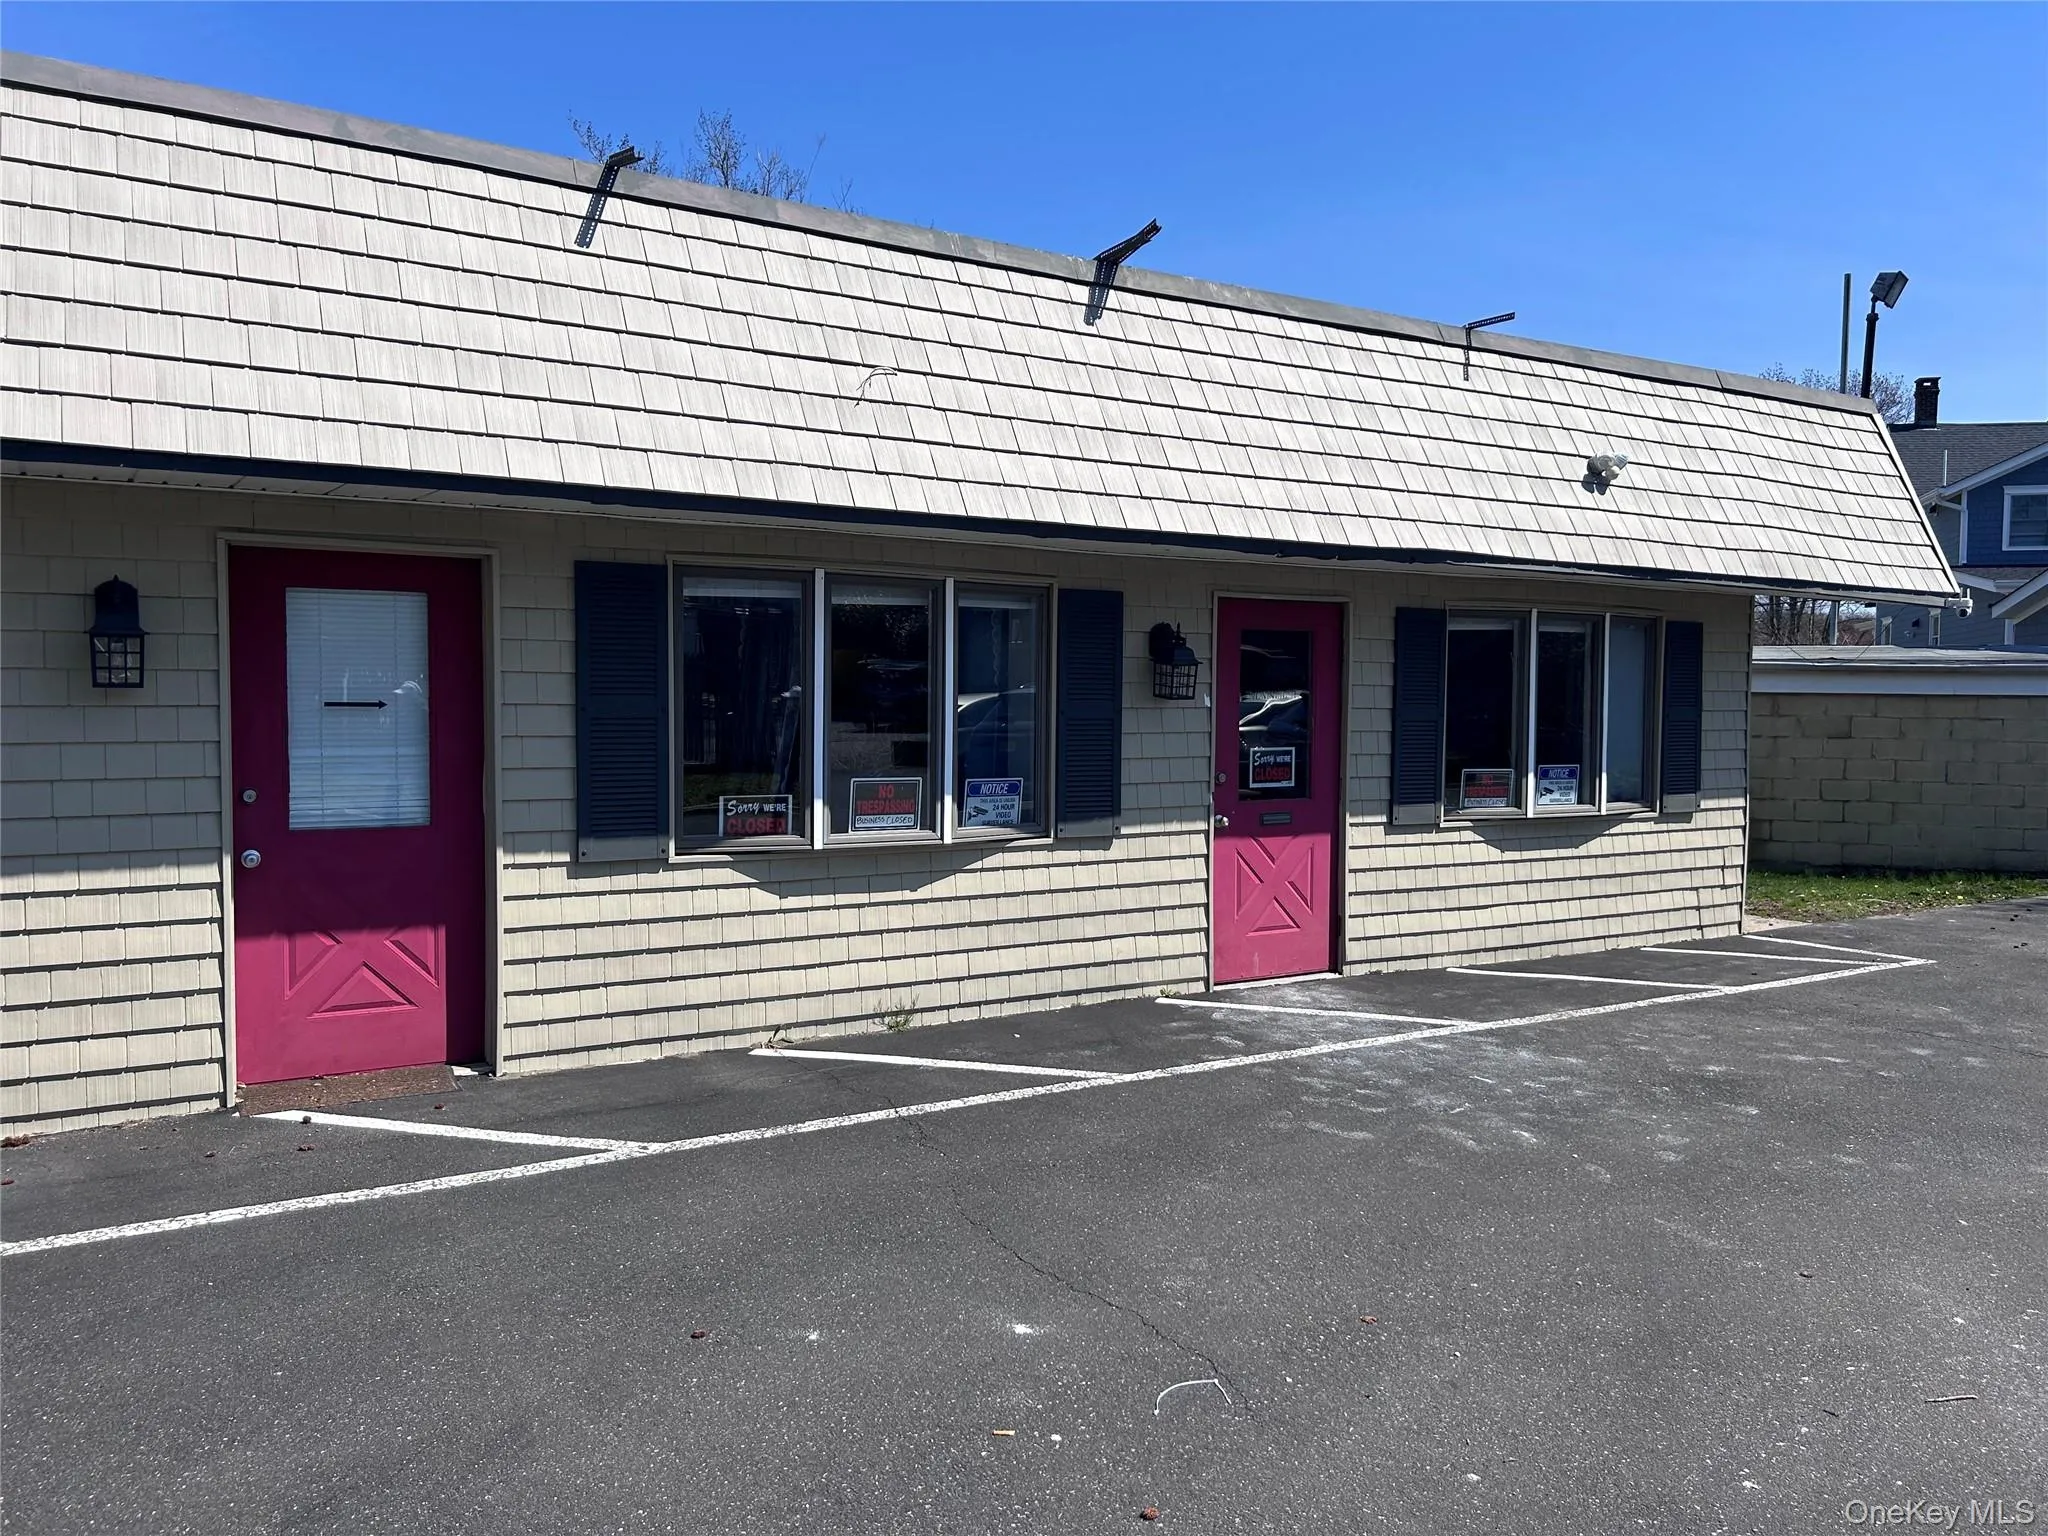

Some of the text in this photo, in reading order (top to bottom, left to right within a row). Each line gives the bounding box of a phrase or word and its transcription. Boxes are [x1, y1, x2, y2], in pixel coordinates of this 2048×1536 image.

[1254, 752, 1274, 766] Sorry
[1254, 767, 1291, 781] CLOSED
[1550, 768, 1570, 778] NOTICE
[878, 784, 895, 798] NO
[980, 783, 1009, 795] NOTICE
[726, 799, 787, 816] Sorry WE'RE
[856, 799, 916, 814] TRESPASSING
[857, 815, 913, 825] BUSINESS CLOSED
[995, 811, 1011, 819] VIDEO
